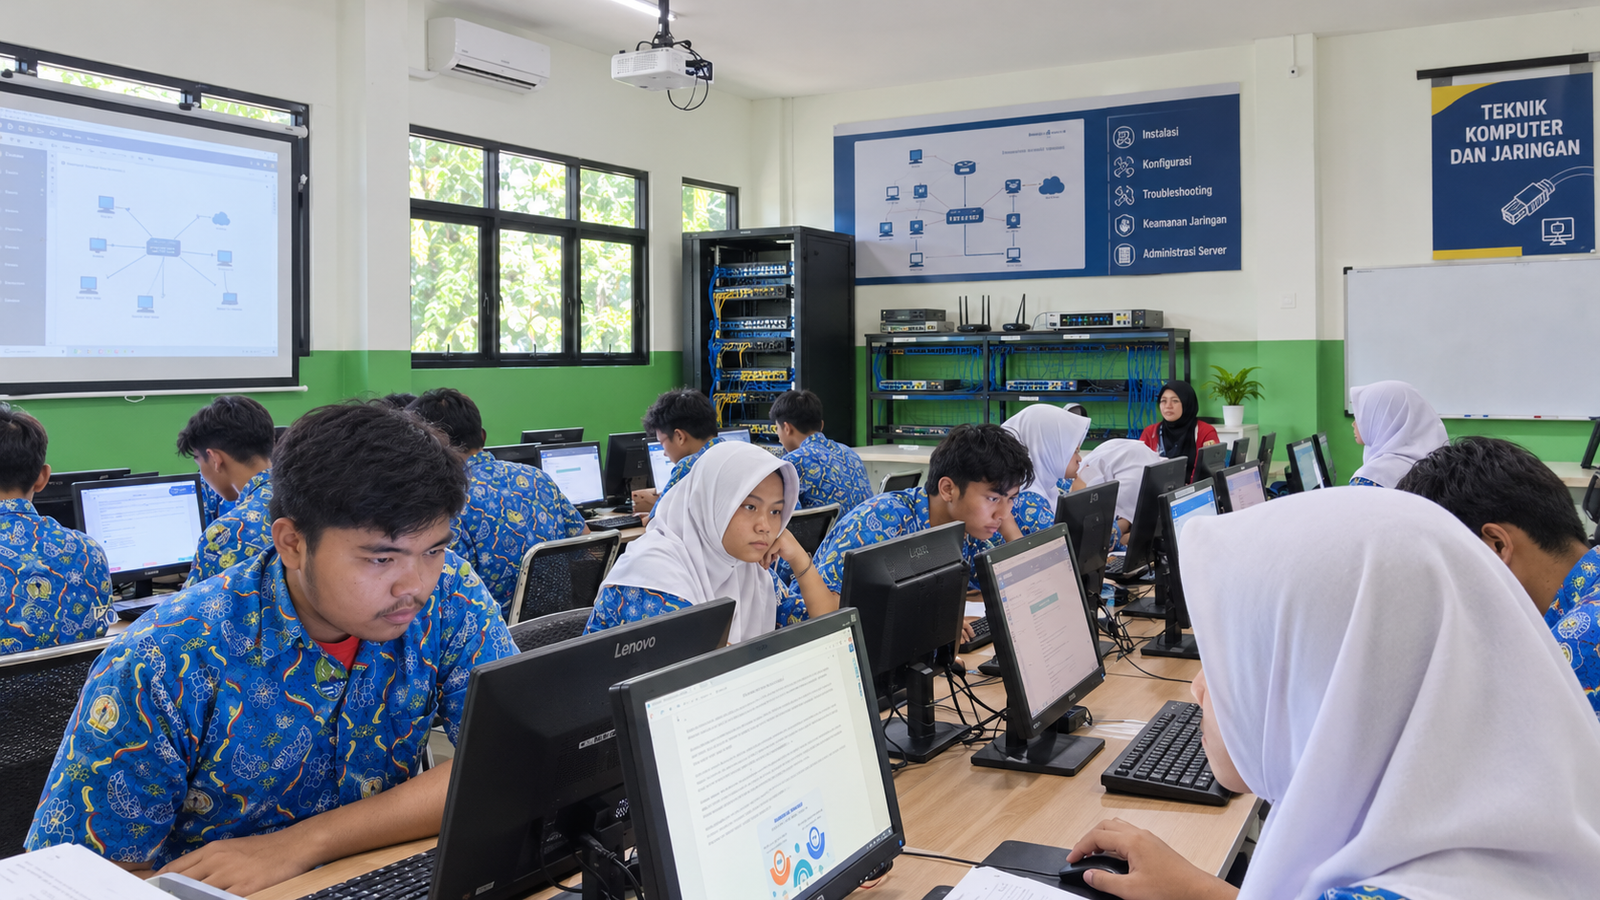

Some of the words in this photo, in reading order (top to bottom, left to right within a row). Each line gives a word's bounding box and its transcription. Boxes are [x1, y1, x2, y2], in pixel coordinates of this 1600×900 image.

[1481, 99, 1547, 120] TEKNIK
[1142, 126, 1179, 139] Instalasi
[1465, 119, 1563, 143] KOMPUTER
[1450, 146, 1487, 165] DAN
[1491, 139, 1580, 161] JARINGAN
[1142, 155, 1192, 169] Konfigurasi
[1142, 185, 1213, 198] Troubleshooting
[1143, 218, 1187, 228] Keamanan
[1189, 215, 1227, 227] Jaringan
[1143, 246, 1196, 258] Administrasi
[1198, 245, 1227, 256] Server
[614, 636, 656, 659] Lenovo
